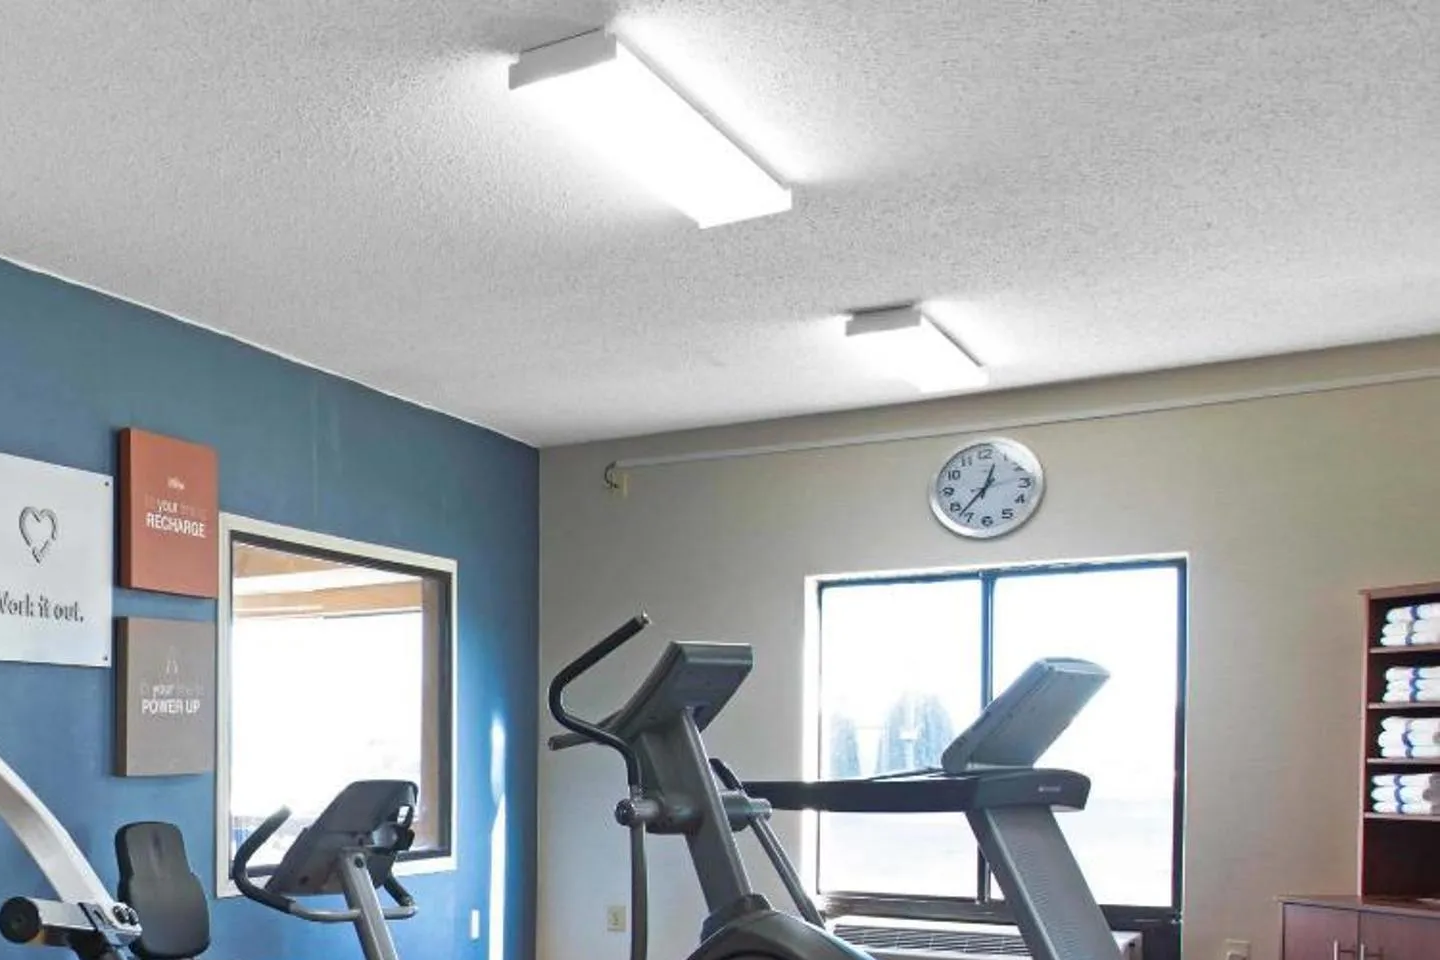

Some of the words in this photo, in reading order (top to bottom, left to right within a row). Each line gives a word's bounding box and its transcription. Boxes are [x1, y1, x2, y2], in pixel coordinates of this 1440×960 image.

[977, 449, 992, 460] 12
[947, 469, 961, 481] 10
[1018, 477, 1032, 489] 3
[1014, 493, 1026, 505] 4
[1001, 507, 1014, 520] 5
[145, 511, 206, 539] RECHARGE
[980, 515, 994, 528] 6
[37, 592, 49, 619] it
[53, 600, 84, 623] out.
[141, 698, 183, 715] POWER
[185, 698, 201, 714] UP
